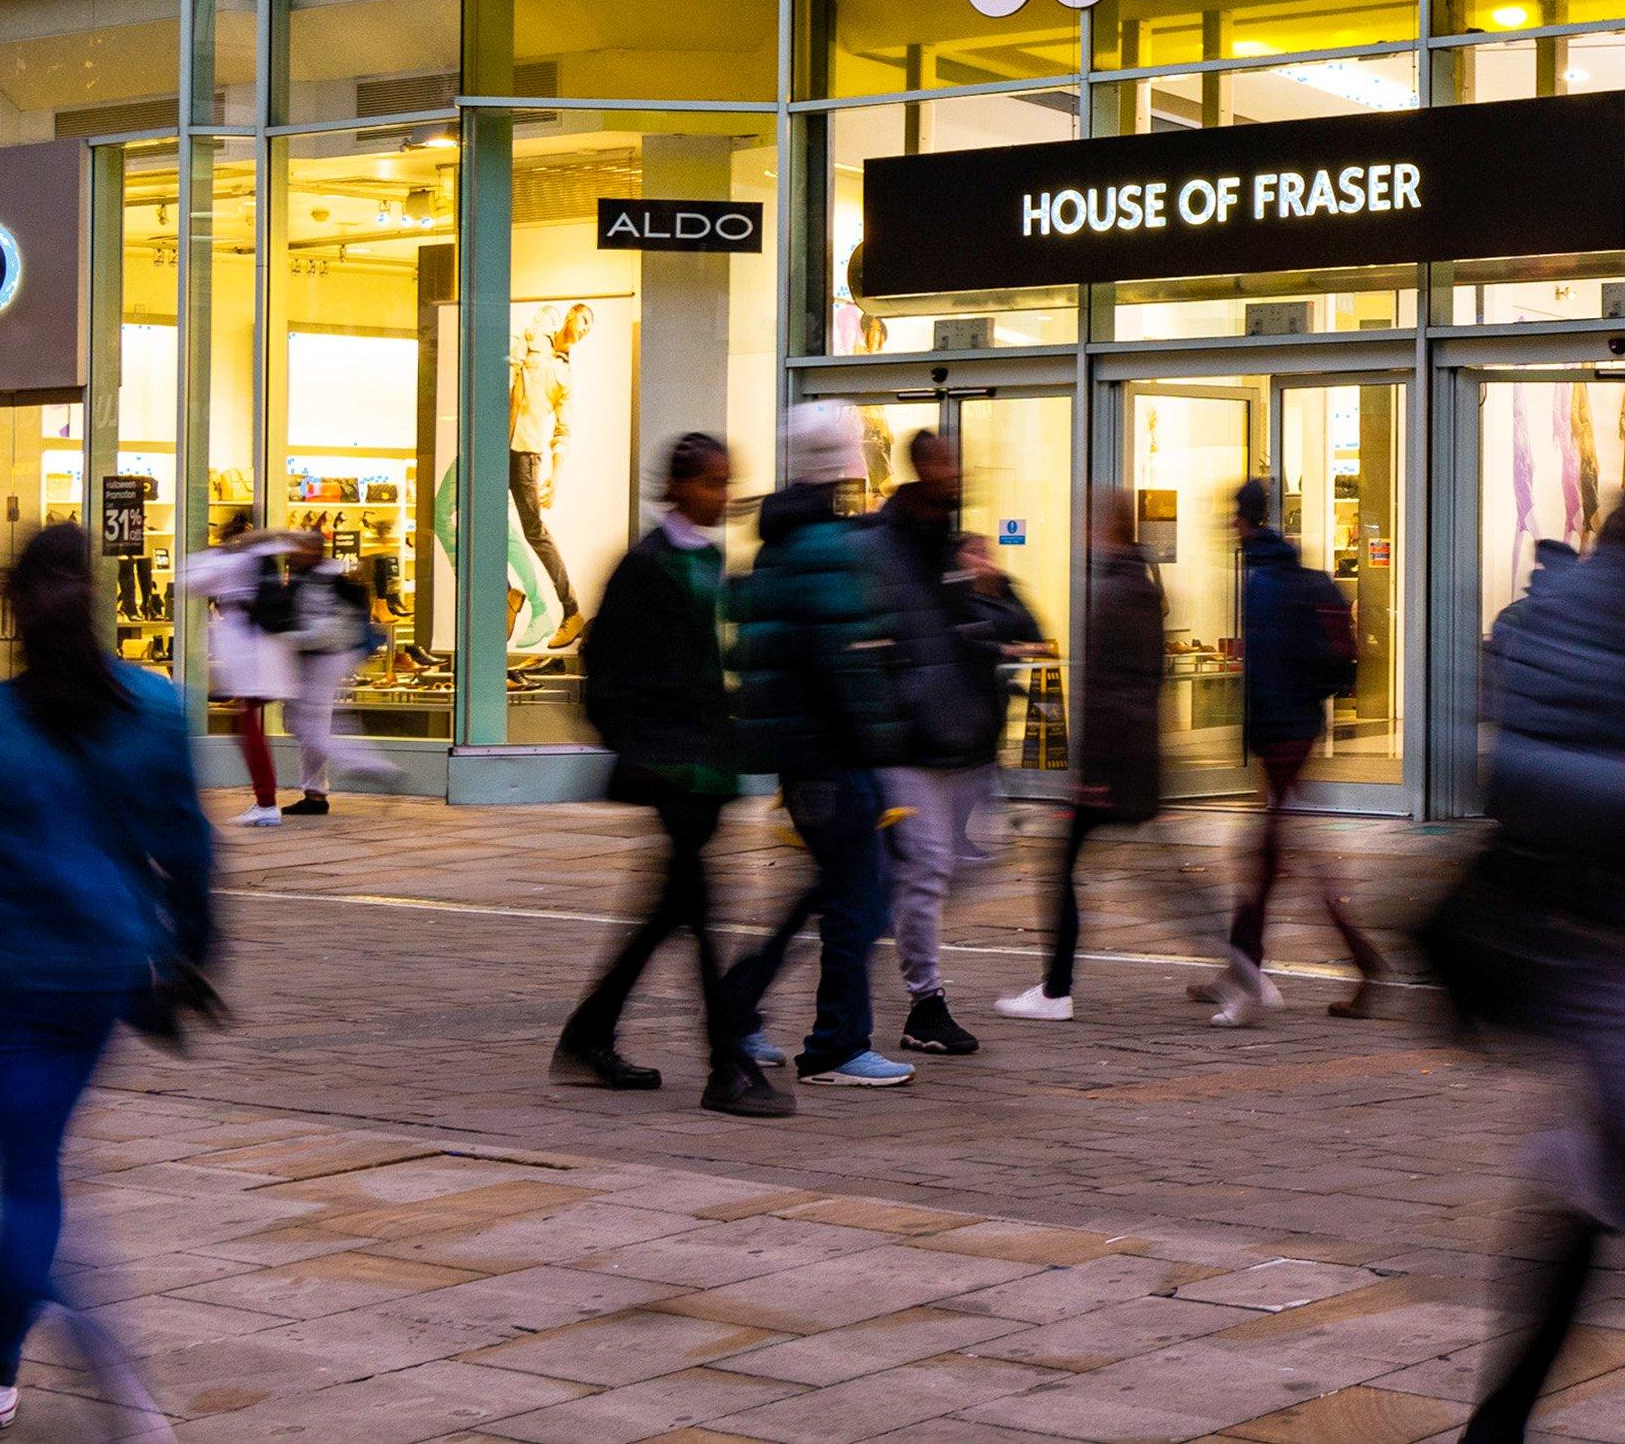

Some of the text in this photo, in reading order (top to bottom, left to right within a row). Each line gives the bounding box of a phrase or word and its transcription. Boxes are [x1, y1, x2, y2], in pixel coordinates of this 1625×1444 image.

[1022, 162, 1422, 237] HOUSE OF FRASER
[606, 211, 754, 241] ALDO
